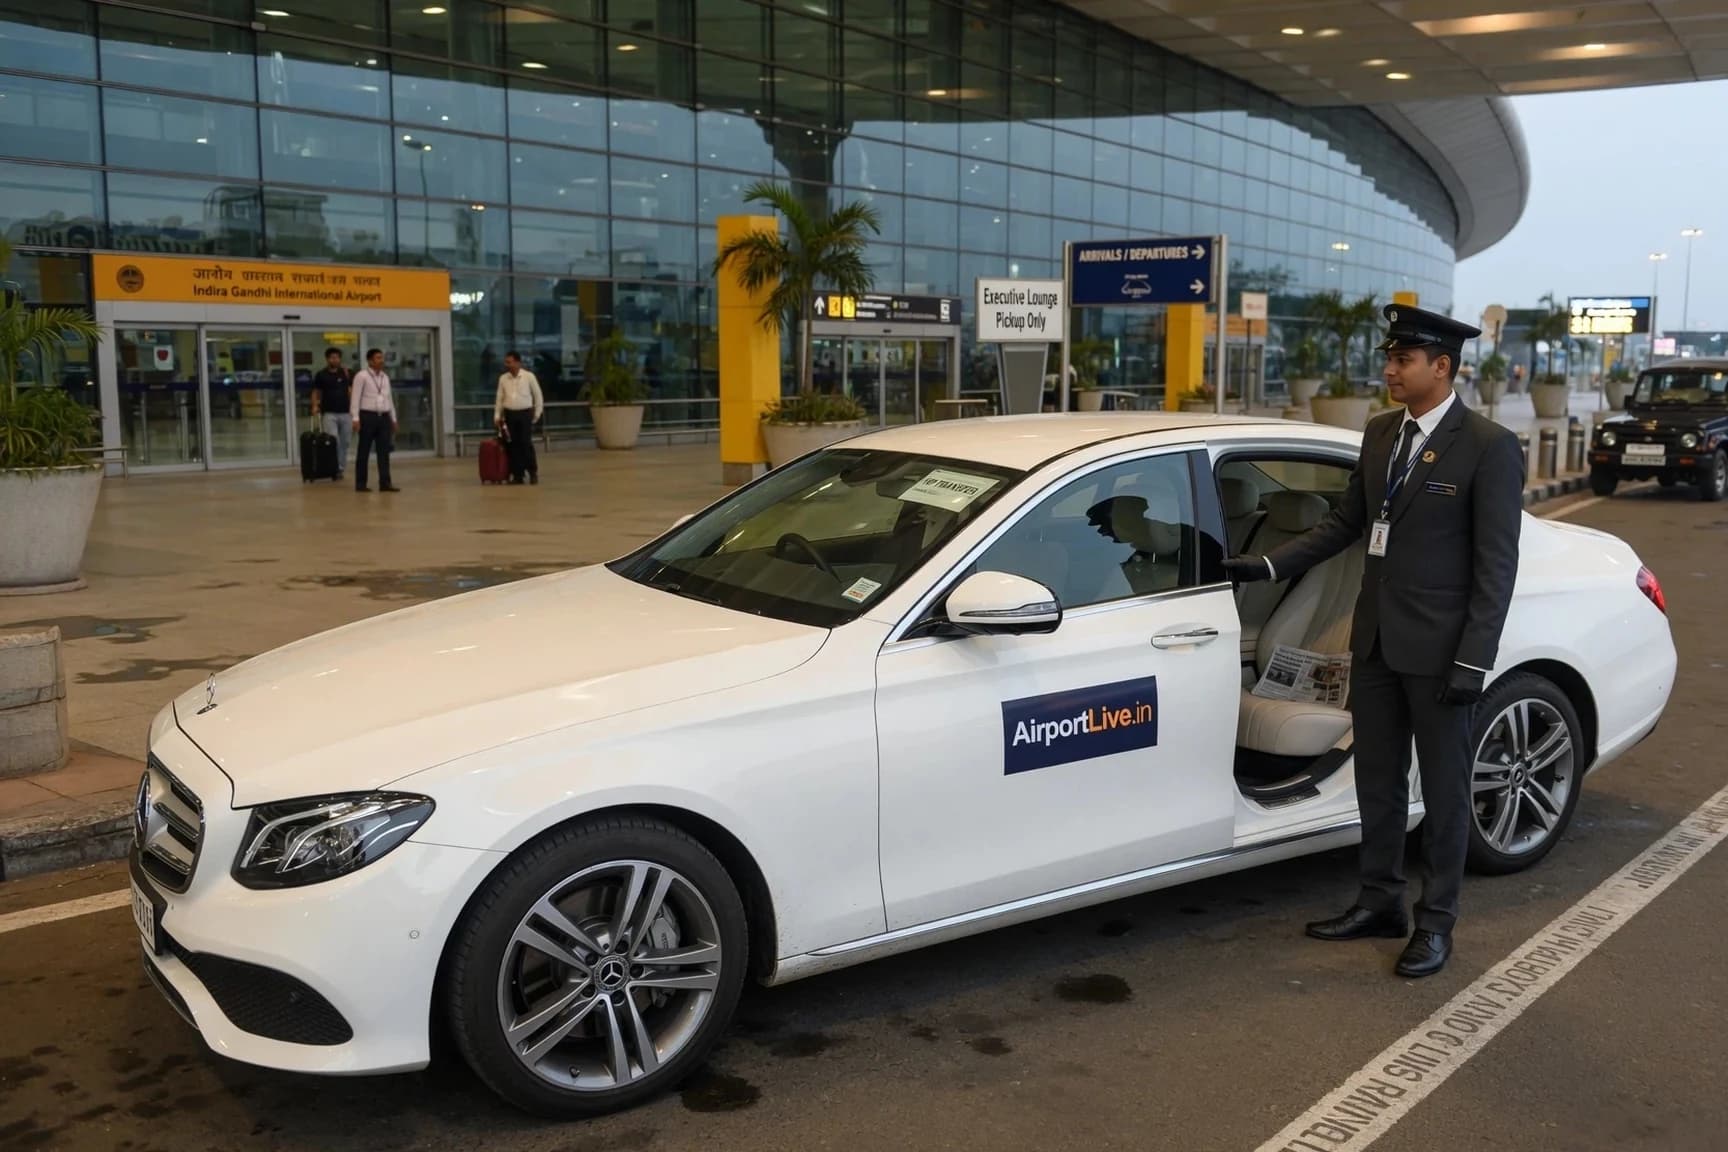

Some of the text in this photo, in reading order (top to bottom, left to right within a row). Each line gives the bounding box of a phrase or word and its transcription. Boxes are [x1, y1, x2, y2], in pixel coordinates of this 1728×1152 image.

[1079, 248, 1122, 262] ARRIVALS
[1129, 245, 1188, 260] DEPARTURES
[193, 284, 382, 304] Indira Gandhi International Airport
[983, 287, 1058, 309] Executive Lounge
[996, 311, 1047, 333] Pickup Only
[1012, 701, 1152, 746] AirportLive.in
